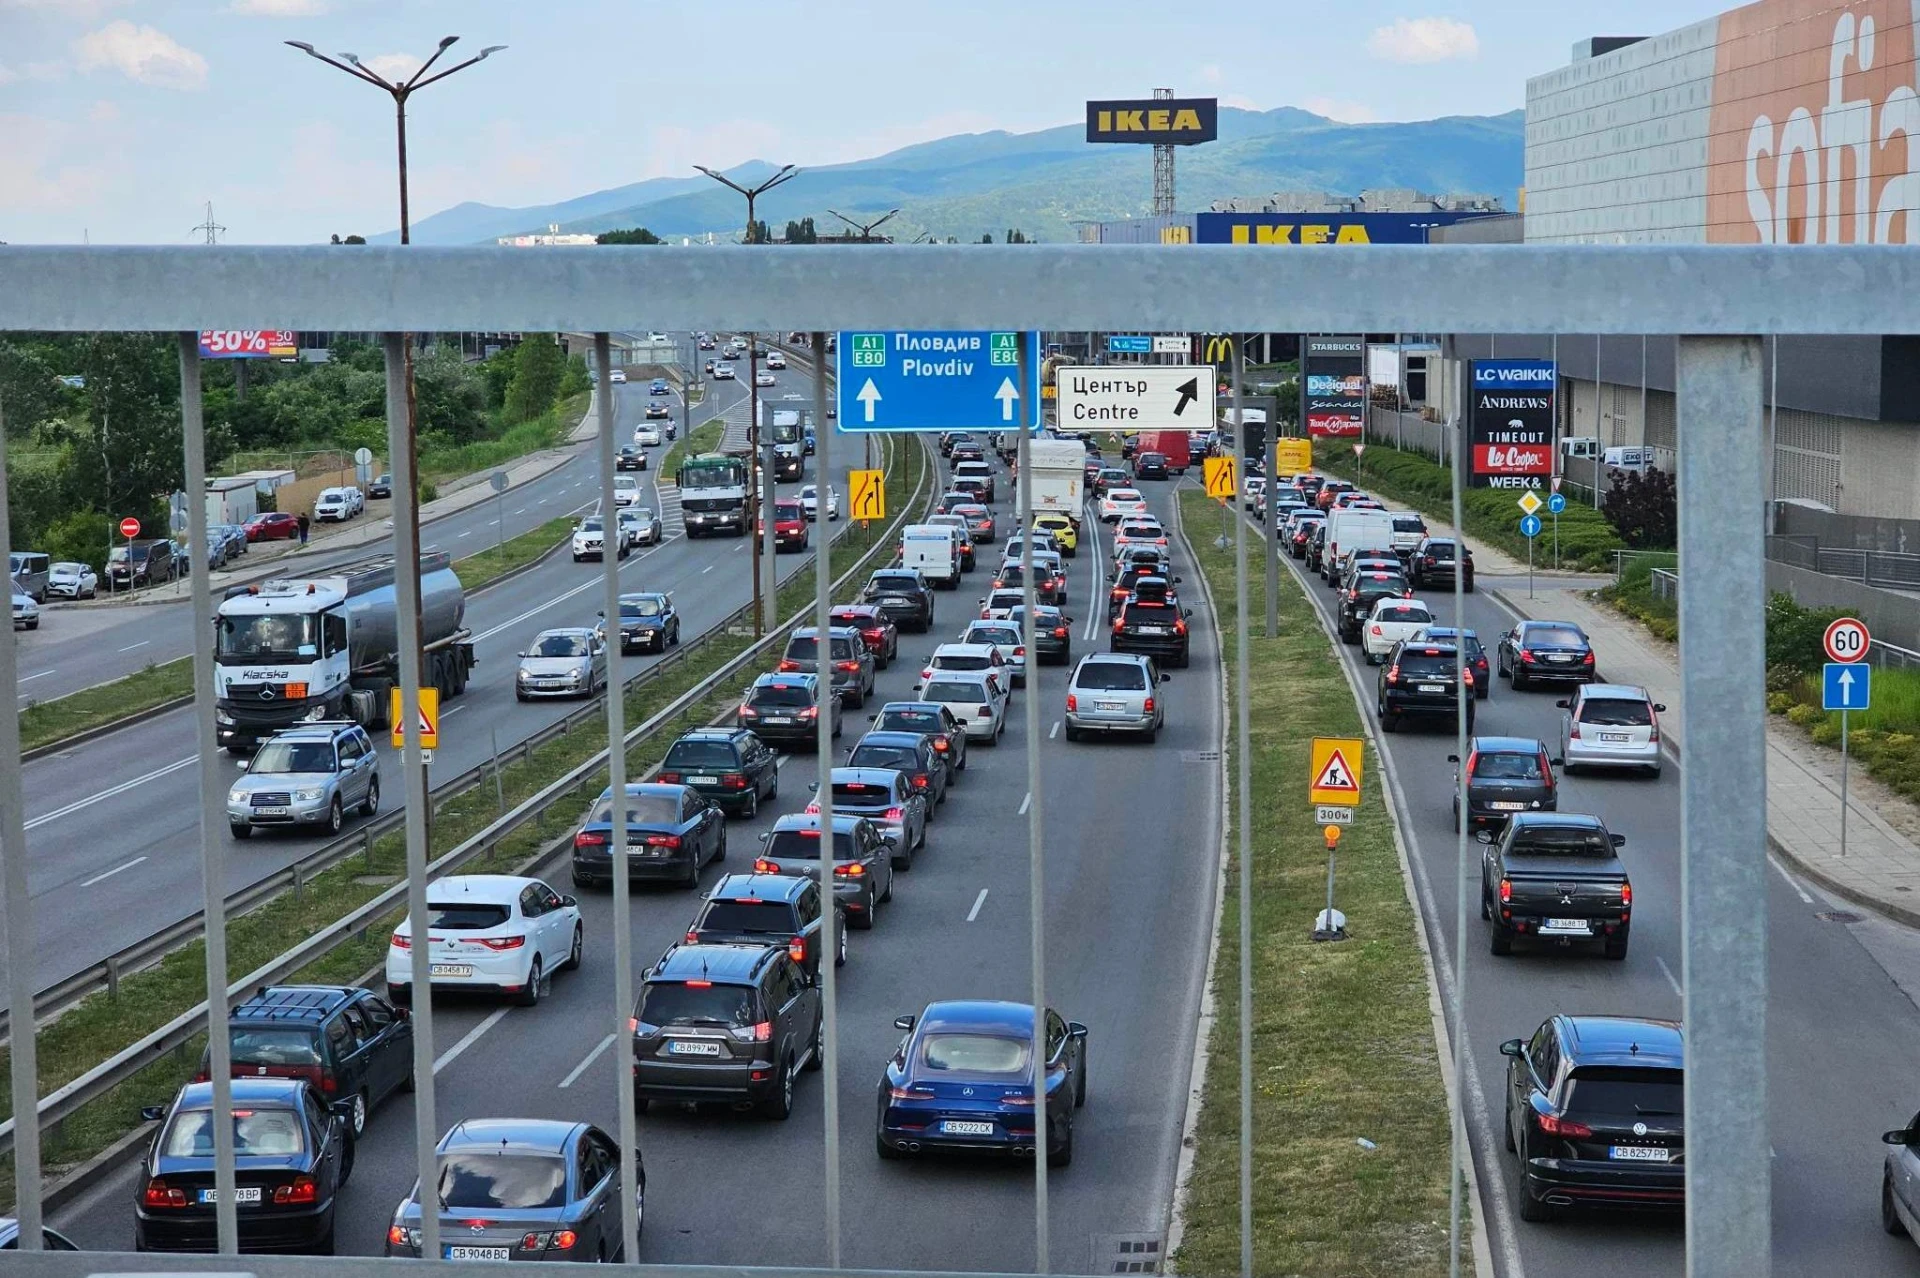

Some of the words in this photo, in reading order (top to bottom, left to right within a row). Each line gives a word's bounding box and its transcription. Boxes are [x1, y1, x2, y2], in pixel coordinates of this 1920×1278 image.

[1098, 109, 1202, 131] IKEA
[201, 331, 266, 351] -50%
[862, 337, 877, 348] A1
[896, 333, 981, 352] Пловдив
[1000, 336, 1015, 347] A1
[1311, 343, 1361, 351] STARBUCKS
[855, 352, 883, 364] E80
[903, 359, 974, 376] Plovdiv
[1476, 369, 1496, 381] LC
[1073, 377, 1148, 396] Център
[1074, 403, 1139, 420] Centre
[1488, 432, 1544, 443] TIMEOUT
[1488, 446, 1505, 467] Lee
[1506, 447, 1543, 471] Cooper
[1489, 477, 1530, 488] WEEK
[1532, 477, 1541, 489] &
[1835, 631, 1859, 651] 60
[242, 670, 289, 680] Klacska
[433, 966, 442, 974] CB
[462, 966, 470, 974] TX
[675, 1043, 685, 1051] CB
[686, 1044, 706, 1053] 8997
[946, 1122, 957, 1131] CB
[960, 1123, 978, 1132] 9222
[980, 1124, 991, 1132] CK
[1616, 1148, 1628, 1157] CB
[1630, 1148, 1652, 1158] 8257
[1654, 1149, 1666, 1158] PP
[246, 1189, 258, 1199] BP
[453, 1248, 466, 1258] CB
[468, 1249, 492, 1259] 9048
[494, 1249, 507, 1259] BC
